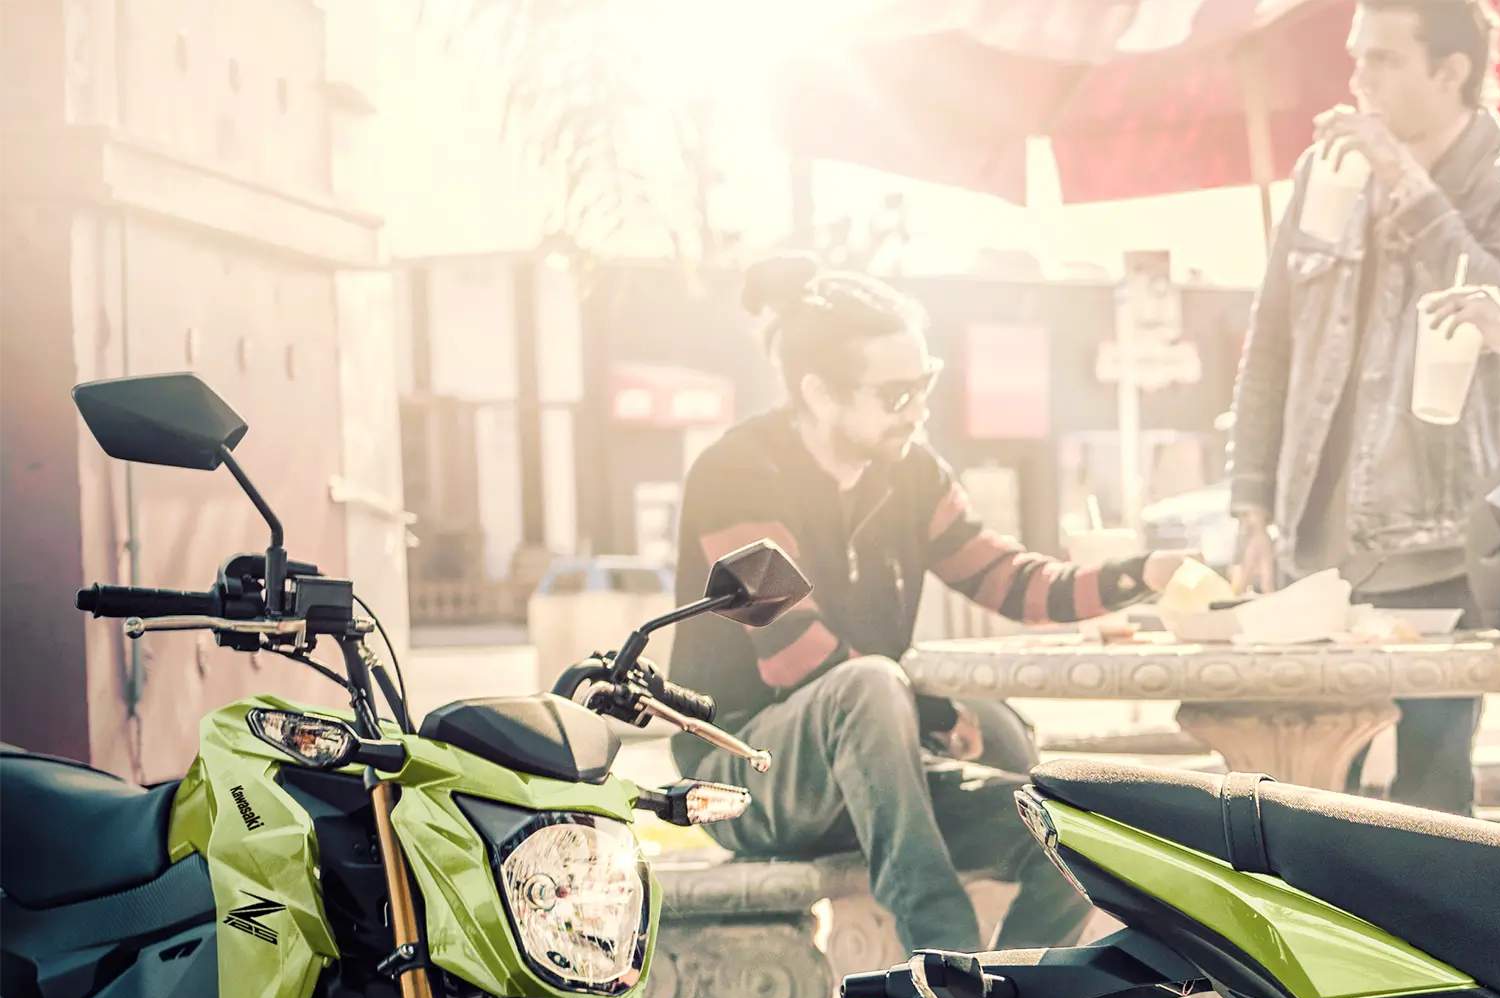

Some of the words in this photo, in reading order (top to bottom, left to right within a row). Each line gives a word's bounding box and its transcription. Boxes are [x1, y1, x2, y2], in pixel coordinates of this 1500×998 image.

[229, 784, 265, 832] Kawasaki
[222, 916, 279, 946] 125
[228, 890, 287, 934] Z
